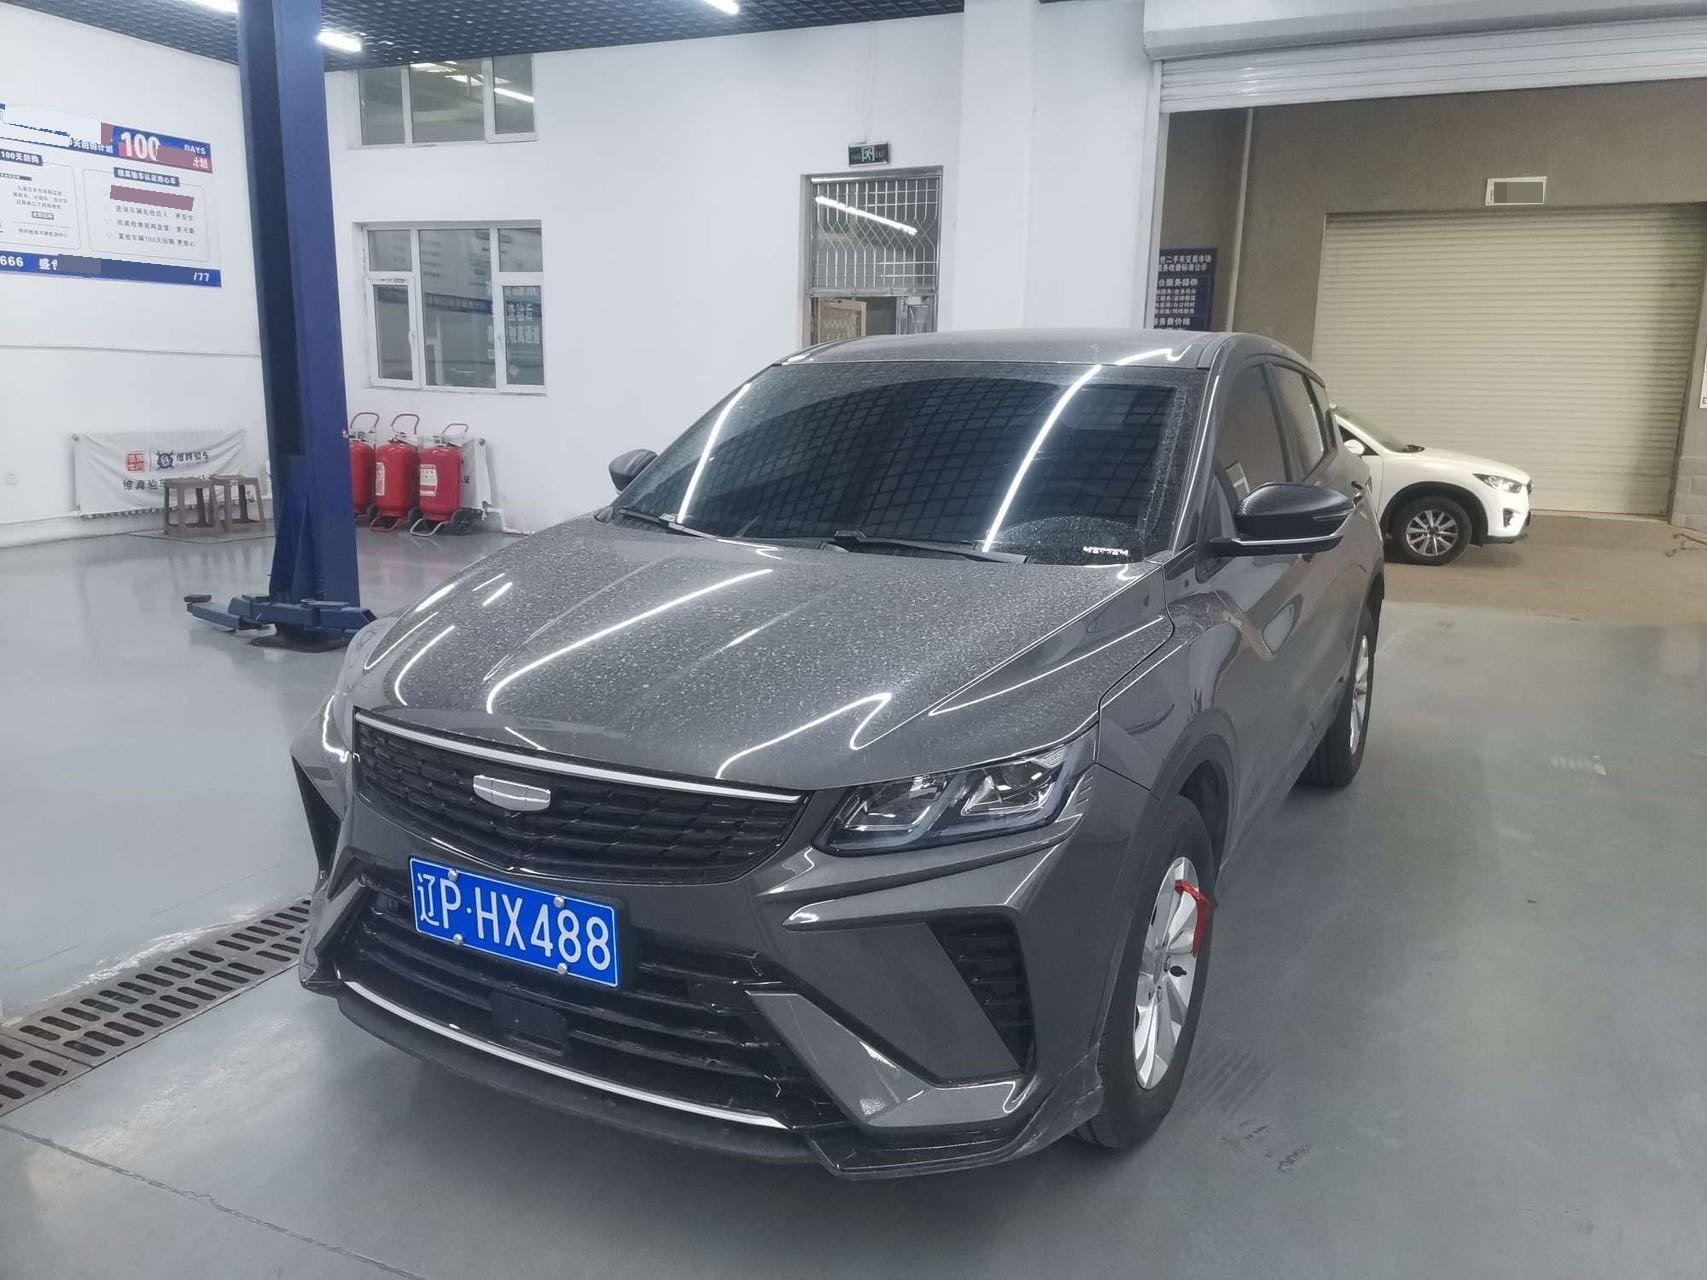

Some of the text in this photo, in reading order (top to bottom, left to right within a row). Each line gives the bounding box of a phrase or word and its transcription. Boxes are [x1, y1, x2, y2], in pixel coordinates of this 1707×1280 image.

[120, 131, 161, 162] 100
[184, 144, 206, 155] DAYS
[416, 872, 611, 971] 辽P·HX488
